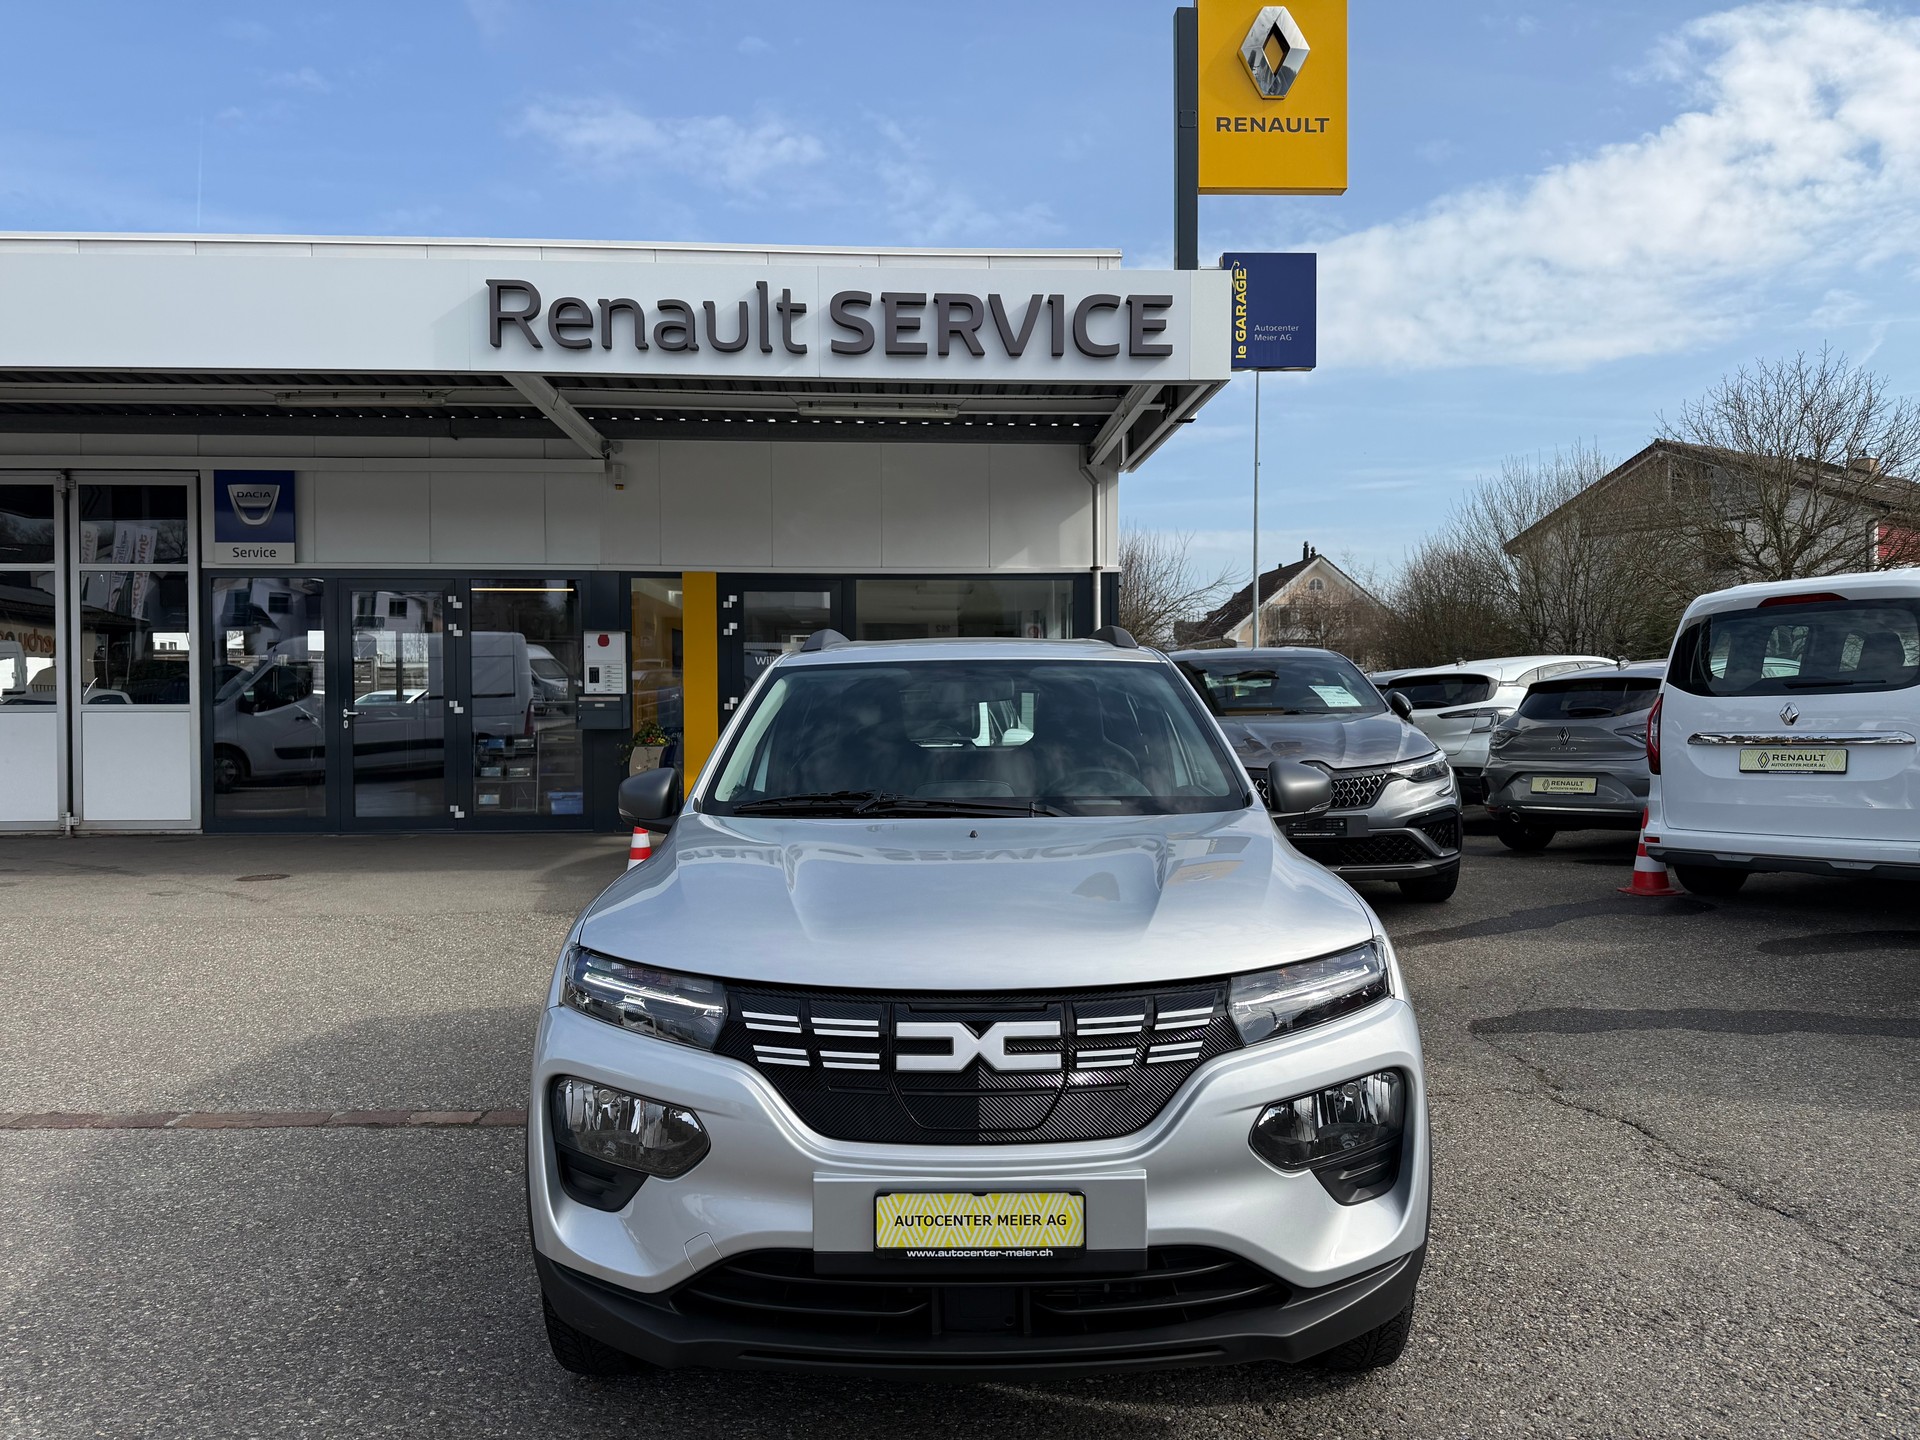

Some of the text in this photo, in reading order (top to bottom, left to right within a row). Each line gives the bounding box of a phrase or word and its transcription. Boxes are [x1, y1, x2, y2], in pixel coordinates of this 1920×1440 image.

[1215, 116, 1330, 133] RENAULT
[485, 278, 1174, 358] Renault SERVICE
[1235, 268, 1247, 359] le GARAGE
[1254, 324, 1299, 332] Autocenter
[232, 546, 277, 558] Service
[1771, 754, 1826, 762] RENAULT
[894, 1214, 1067, 1227] AUTOCENTER MEIER AG
[906, 1248, 1053, 1257] www.autocenter-meier.ch
